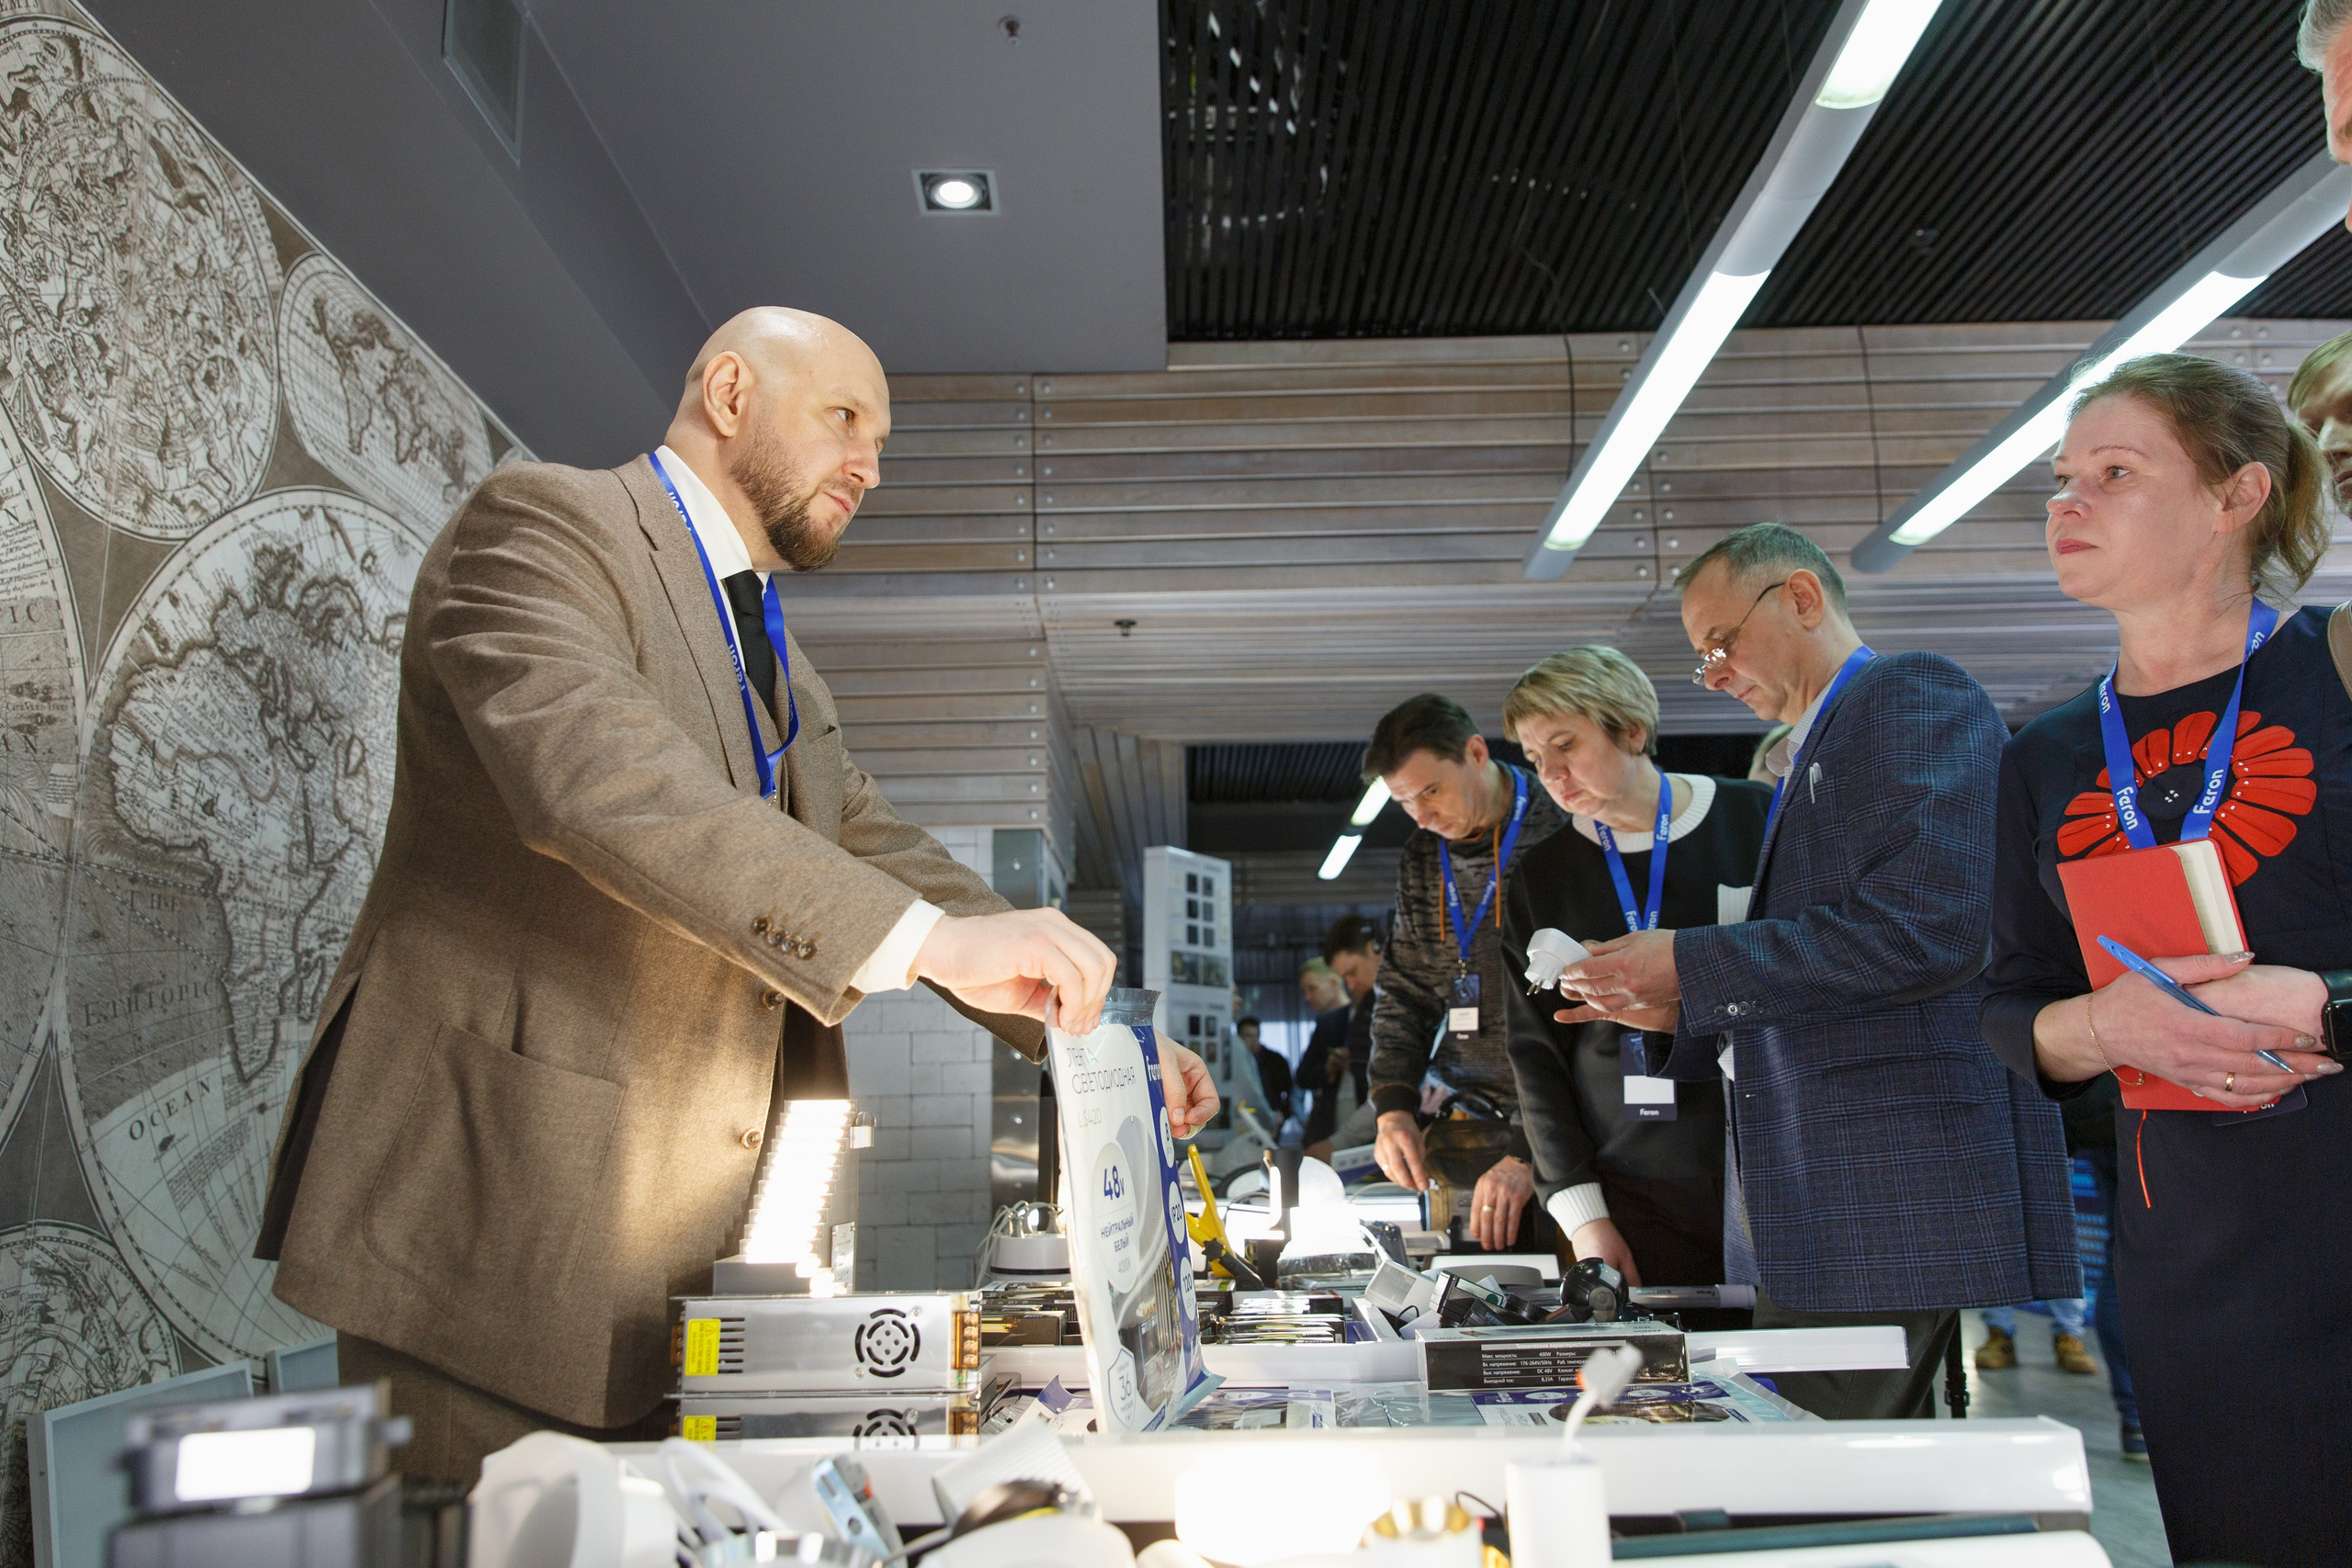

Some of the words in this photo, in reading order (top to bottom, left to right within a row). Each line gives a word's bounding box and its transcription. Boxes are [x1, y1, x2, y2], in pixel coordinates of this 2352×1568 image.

[2193, 769, 2224, 815] Feron
[2116, 785, 2139, 830] Feron
[1598, 824, 1612, 852] Feron
[1656, 814, 1669, 840] Feron
[1625, 910, 1638, 931] Fero
[1067, 1047, 1099, 1066] ЛЕНТА
[1071, 1066, 1136, 1094] СВЕТОДИОДНАЯ
[129, 1075, 214, 1142] OCEAN
[1101, 1213, 1134, 1239] НЕЙТРАЛЬНЫЙ
[1170, 1203, 1182, 1224] IP20
[1114, 1233, 1129, 1252] БЕЛЫЙ
[1182, 1273, 1193, 1293] 120
[1119, 1371, 1132, 1401] 36
